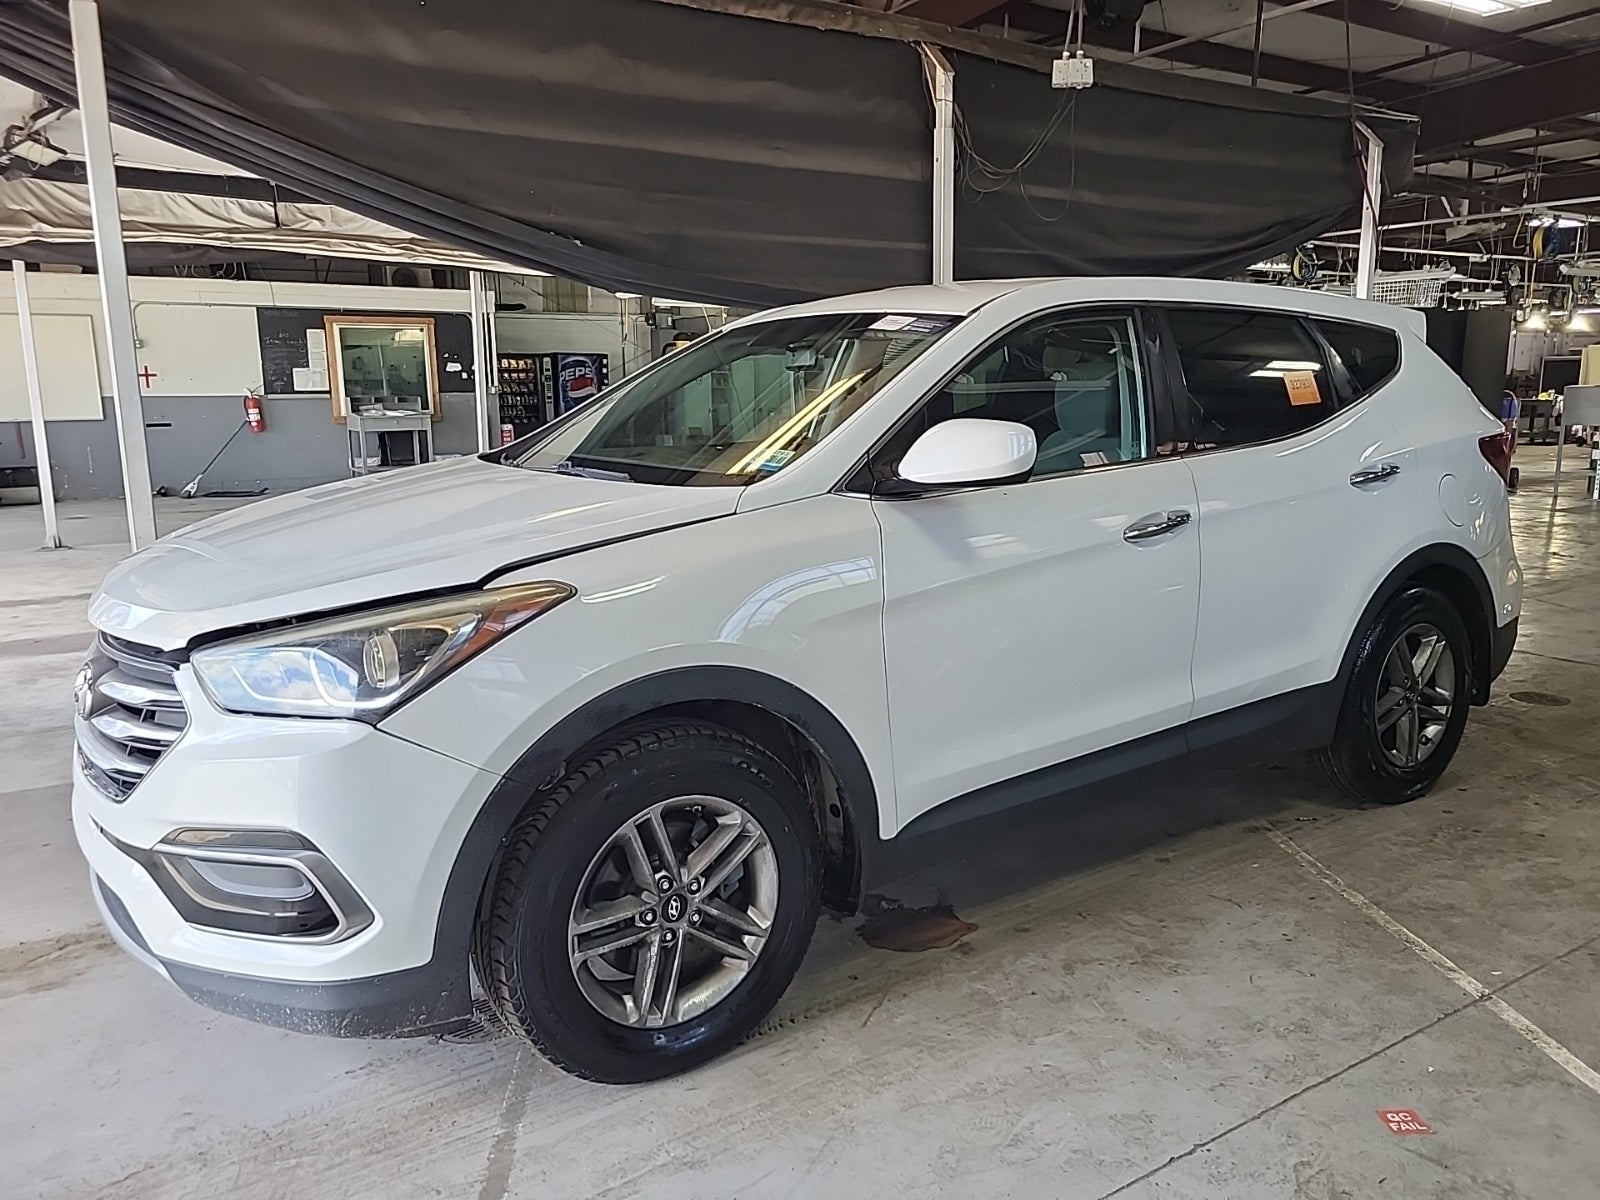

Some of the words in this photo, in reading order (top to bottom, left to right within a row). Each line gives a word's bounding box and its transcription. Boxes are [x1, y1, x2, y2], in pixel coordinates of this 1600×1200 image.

[559, 367, 595, 381] PEPS
[1386, 1112, 1412, 1121] QC
[1388, 1121, 1427, 1131] FAIL
